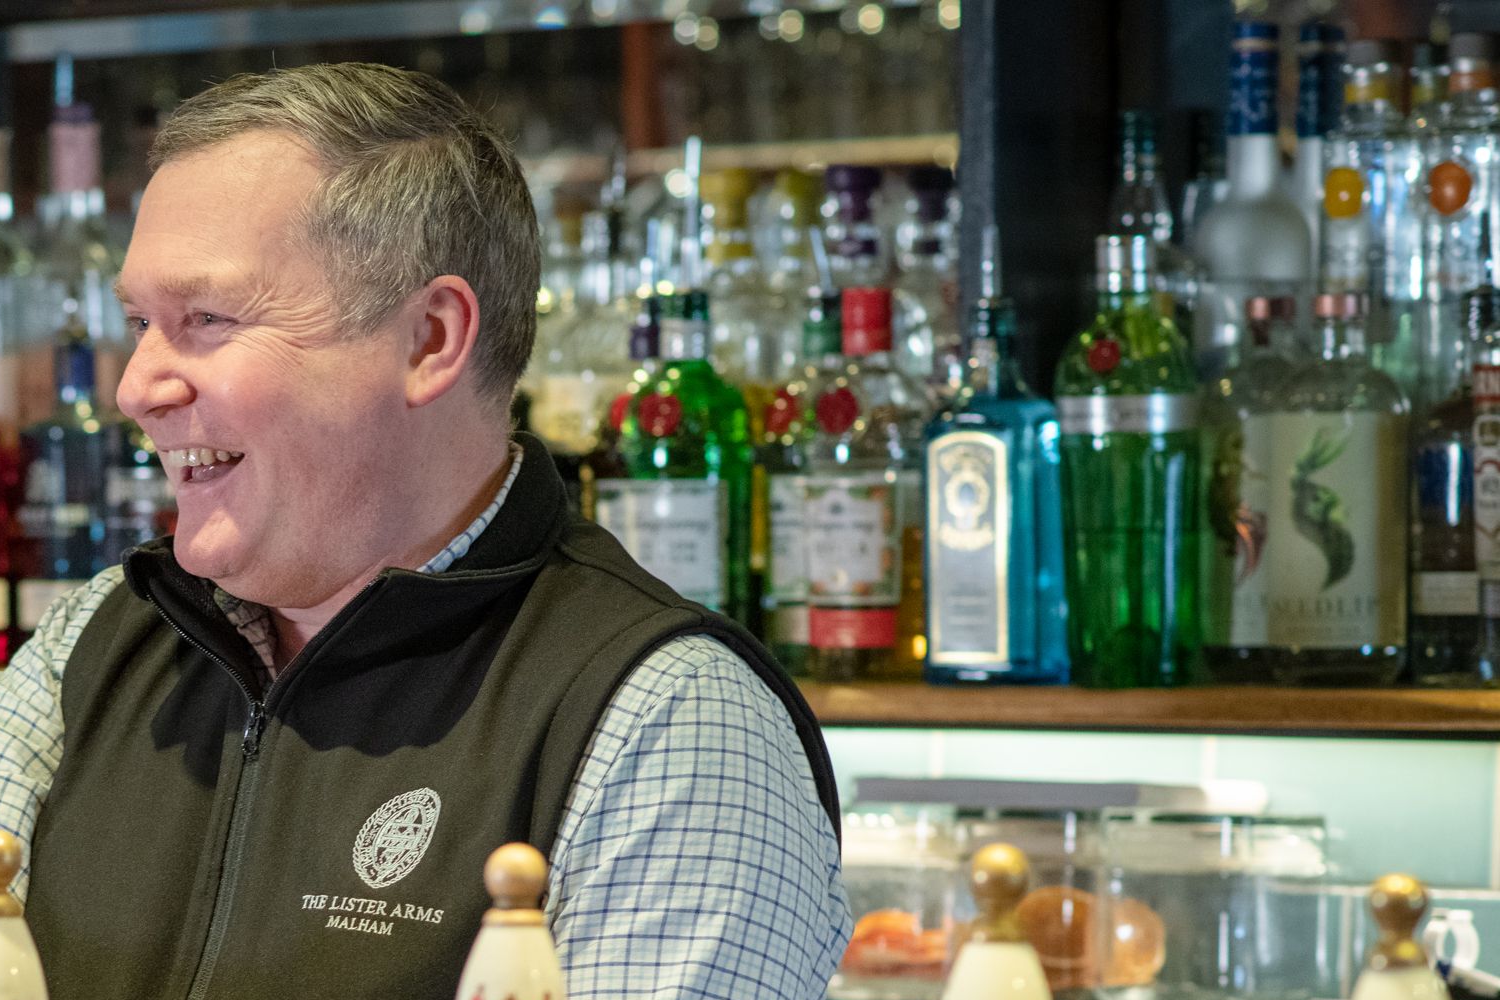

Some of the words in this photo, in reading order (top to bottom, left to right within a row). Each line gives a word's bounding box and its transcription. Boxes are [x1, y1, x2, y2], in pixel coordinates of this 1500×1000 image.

[302, 894, 328, 910] THE
[329, 895, 388, 916] LISTER
[389, 903, 444, 924] ARMS
[325, 915, 394, 935] MALHAM
